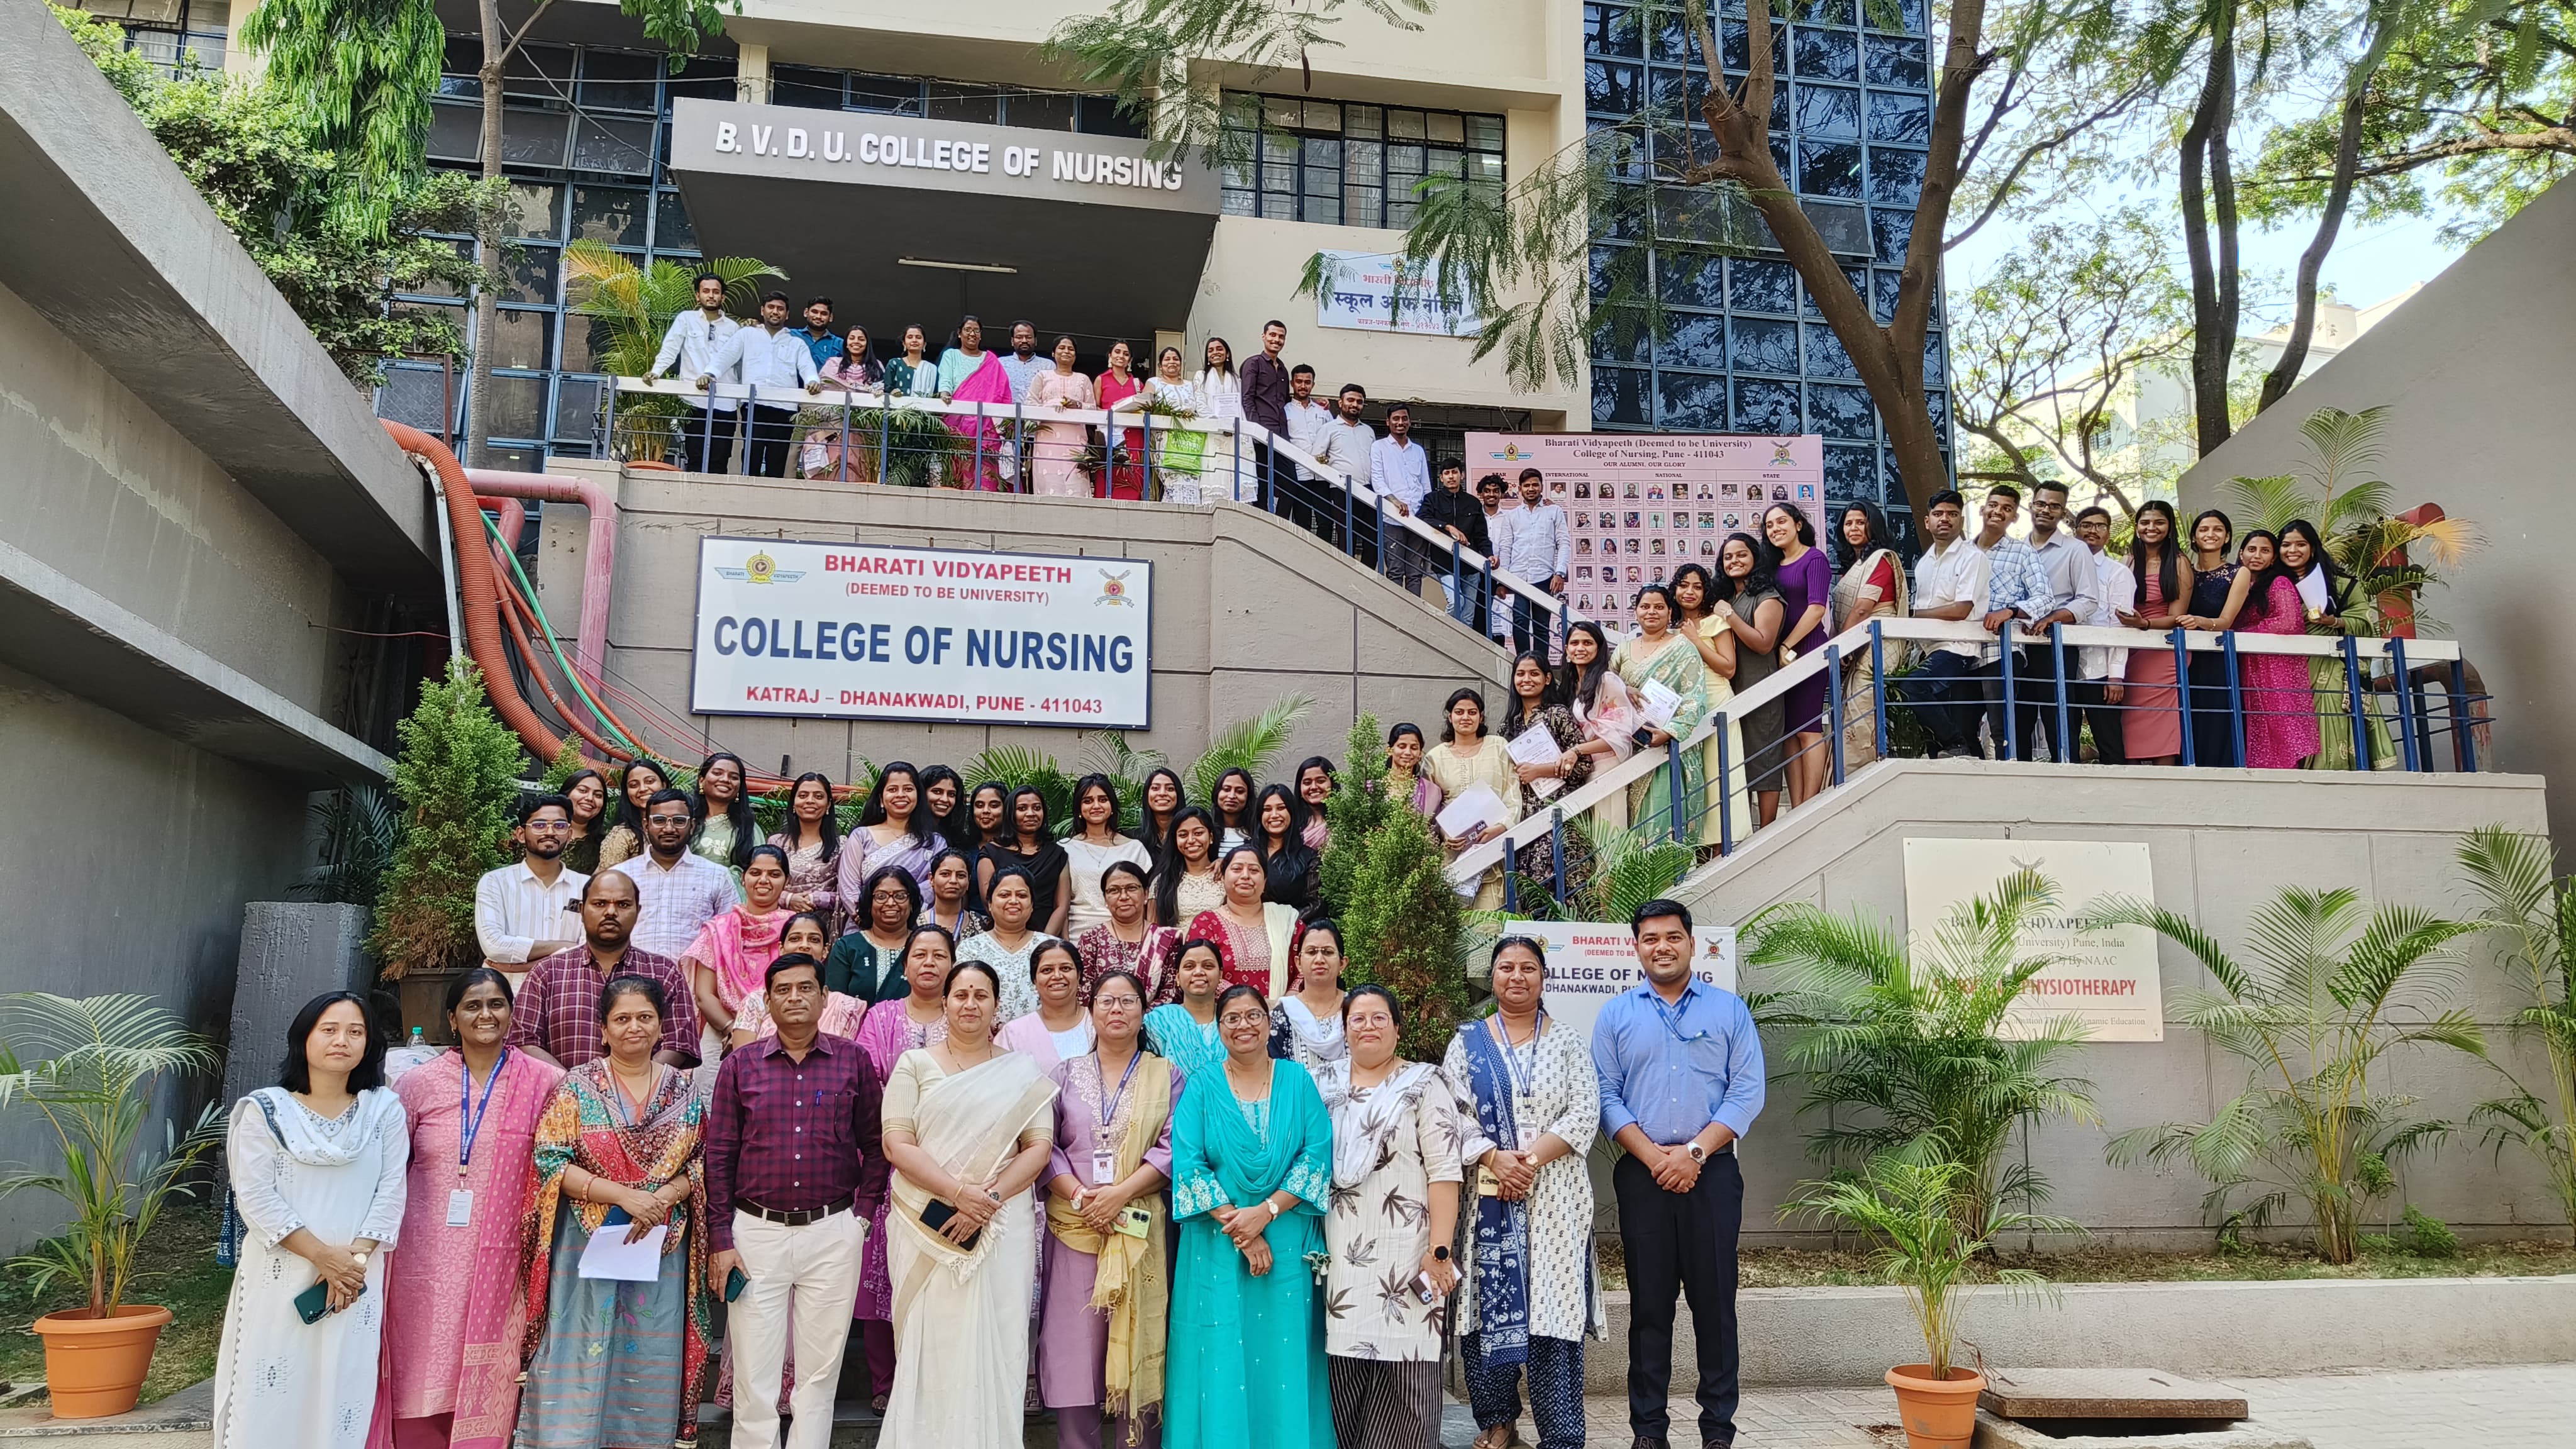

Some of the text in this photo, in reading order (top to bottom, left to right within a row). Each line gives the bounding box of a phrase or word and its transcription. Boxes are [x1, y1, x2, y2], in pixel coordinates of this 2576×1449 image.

[860, 133, 989, 173] COLLEGE
[1004, 147, 1040, 177] OF
[1052, 150, 1183, 191] NURSING
[1363, 274, 1391, 284] भारती
[1333, 291, 1374, 314] स्कूल
[1545, 438, 1752, 450] Bharati Vidyapeeth (Deemed to be University)
[1573, 449, 1607, 460] College
[1608, 450, 1619, 458] of
[1620, 450, 1660, 460] Nursing,
[1662, 450, 1685, 458] Pune
[1693, 450, 1725, 458] 411043
[825, 555, 1072, 584] BHARATI VIDYAPEETH
[845, 582, 1050, 607] (DEEMED TO BE UNIVERSITY)
[714, 616, 1133, 674] COLLEGE OF NURSING
[746, 687, 820, 706] KATRAJ
[840, 690, 970, 713] DHANAKWADI,
[976, 696, 1025, 713] PUNE
[1040, 698, 1102, 714] 411043
[1572, 935, 1621, 947] BHARATI
[2072, 936, 2099, 948] Pune,
[2101, 937, 2126, 948] India
[1584, 948, 1614, 957] (DEEMED
[2084, 955, 2118, 966] NAAC
[1544, 967, 1604, 981] OLLEGE
[1609, 968, 1631, 981] OF
[1545, 983, 1618, 995] DHANAKWADI,
[2021, 978, 2136, 996] PHYSIOTHERAPY
[2110, 1017, 2146, 1026] Education
